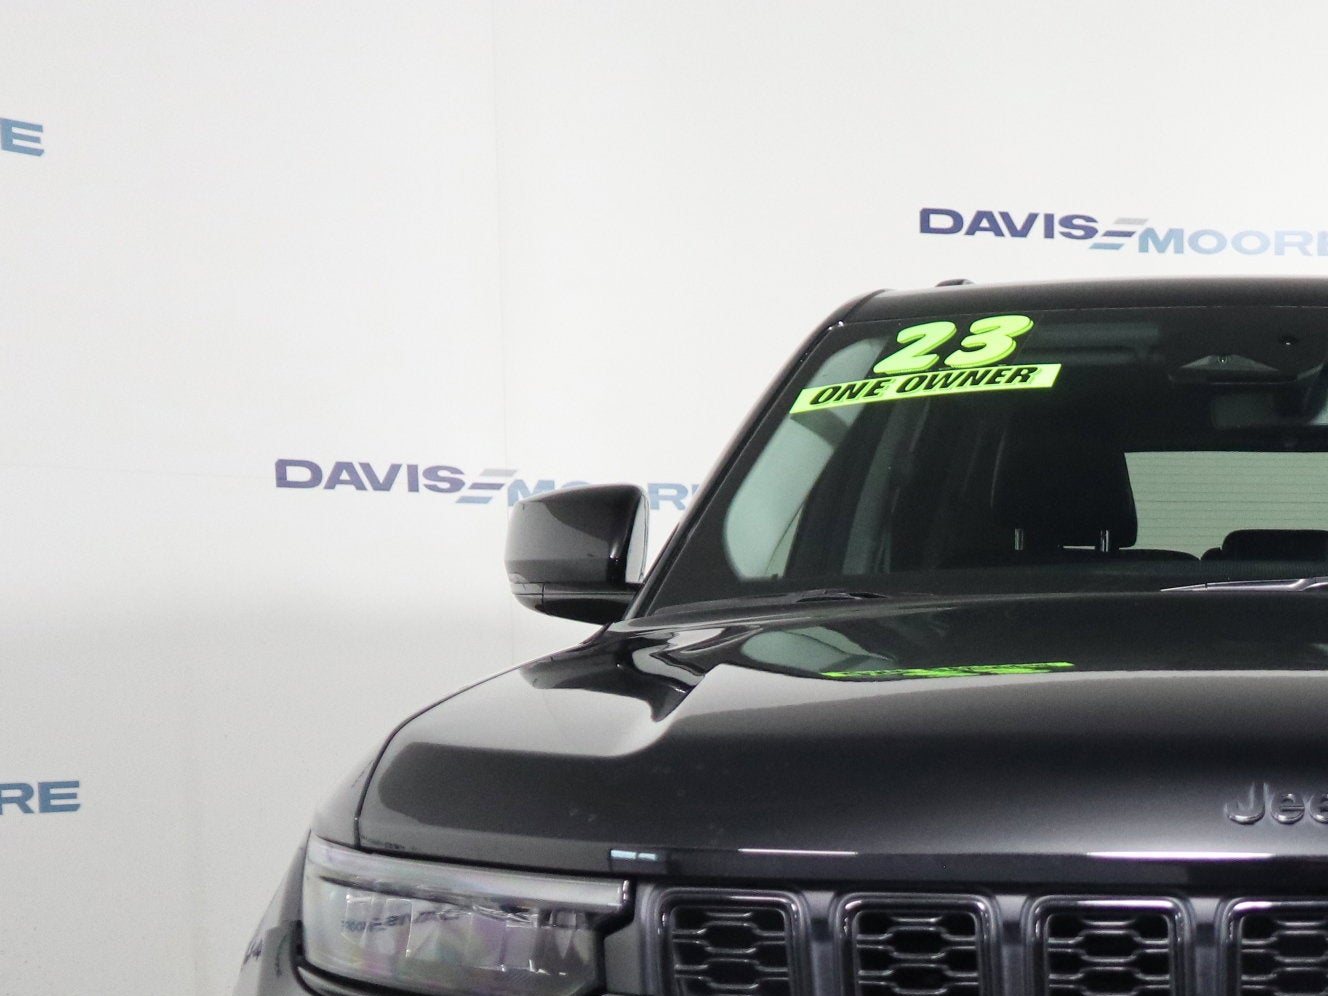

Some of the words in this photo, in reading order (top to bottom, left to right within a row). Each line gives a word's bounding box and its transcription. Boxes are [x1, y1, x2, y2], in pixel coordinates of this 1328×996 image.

[918, 206, 1099, 241] DAVIS
[873, 314, 1034, 376] 23
[809, 378, 892, 406] ONE
[896, 366, 1041, 394] OWNER
[274, 458, 466, 494] DAVIS
